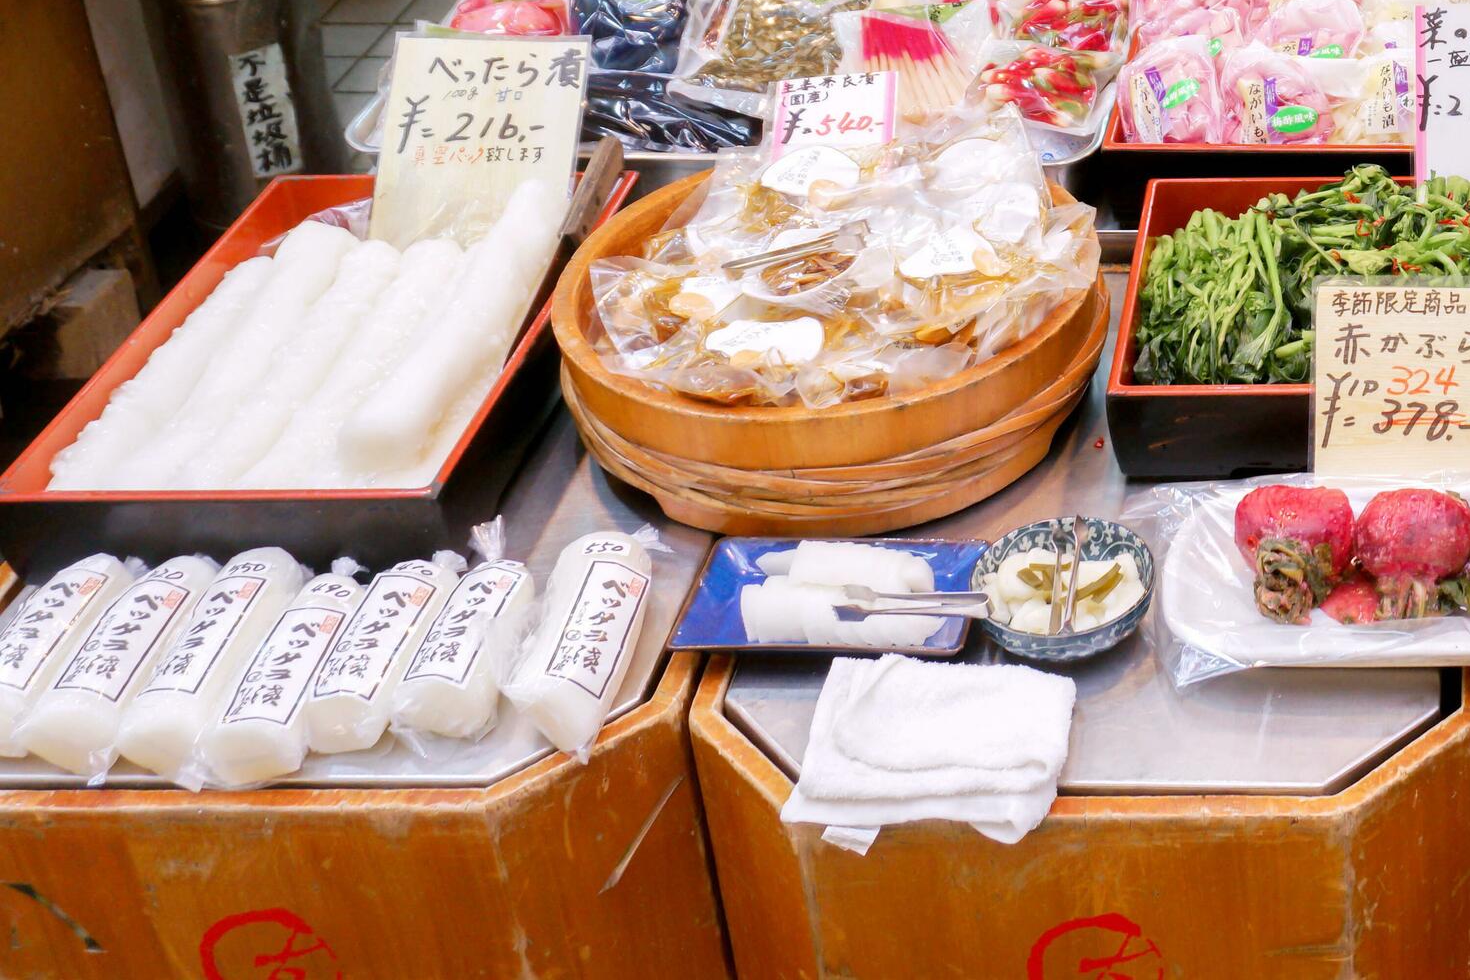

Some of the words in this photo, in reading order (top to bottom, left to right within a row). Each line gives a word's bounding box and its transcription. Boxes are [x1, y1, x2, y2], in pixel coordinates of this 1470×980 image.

[429, 48, 586, 89] べったら漬
[496, 88, 523, 102] 甘口
[412, 146, 545, 165] 真空パック致します
[1332, 290, 1466, 316] 季節限定商品
[1386, 365, 1459, 396] 324
[584, 542, 624, 555] 550
